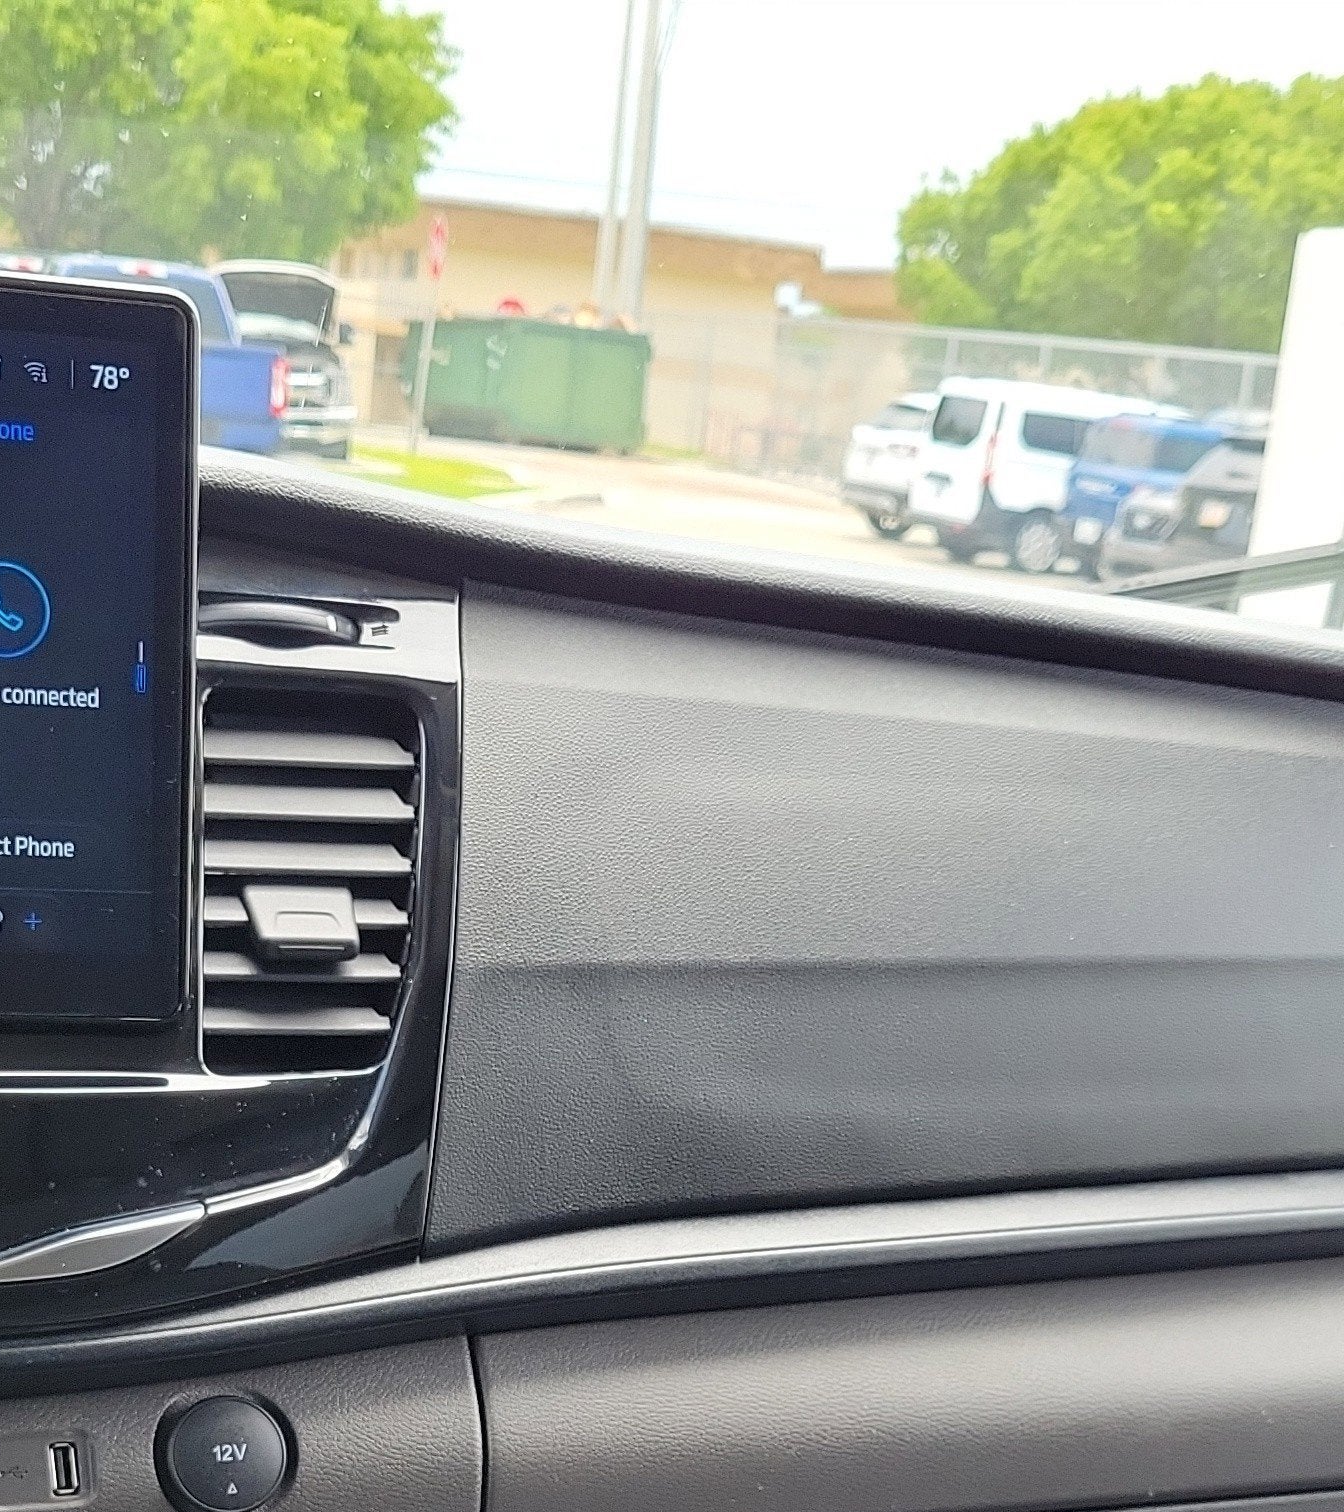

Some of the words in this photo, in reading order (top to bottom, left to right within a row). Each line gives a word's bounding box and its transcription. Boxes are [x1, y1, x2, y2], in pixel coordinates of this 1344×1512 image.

[1, 684, 101, 709] connected
[14, 835, 75, 858] Phone
[212, 1443, 248, 1462] 12V
